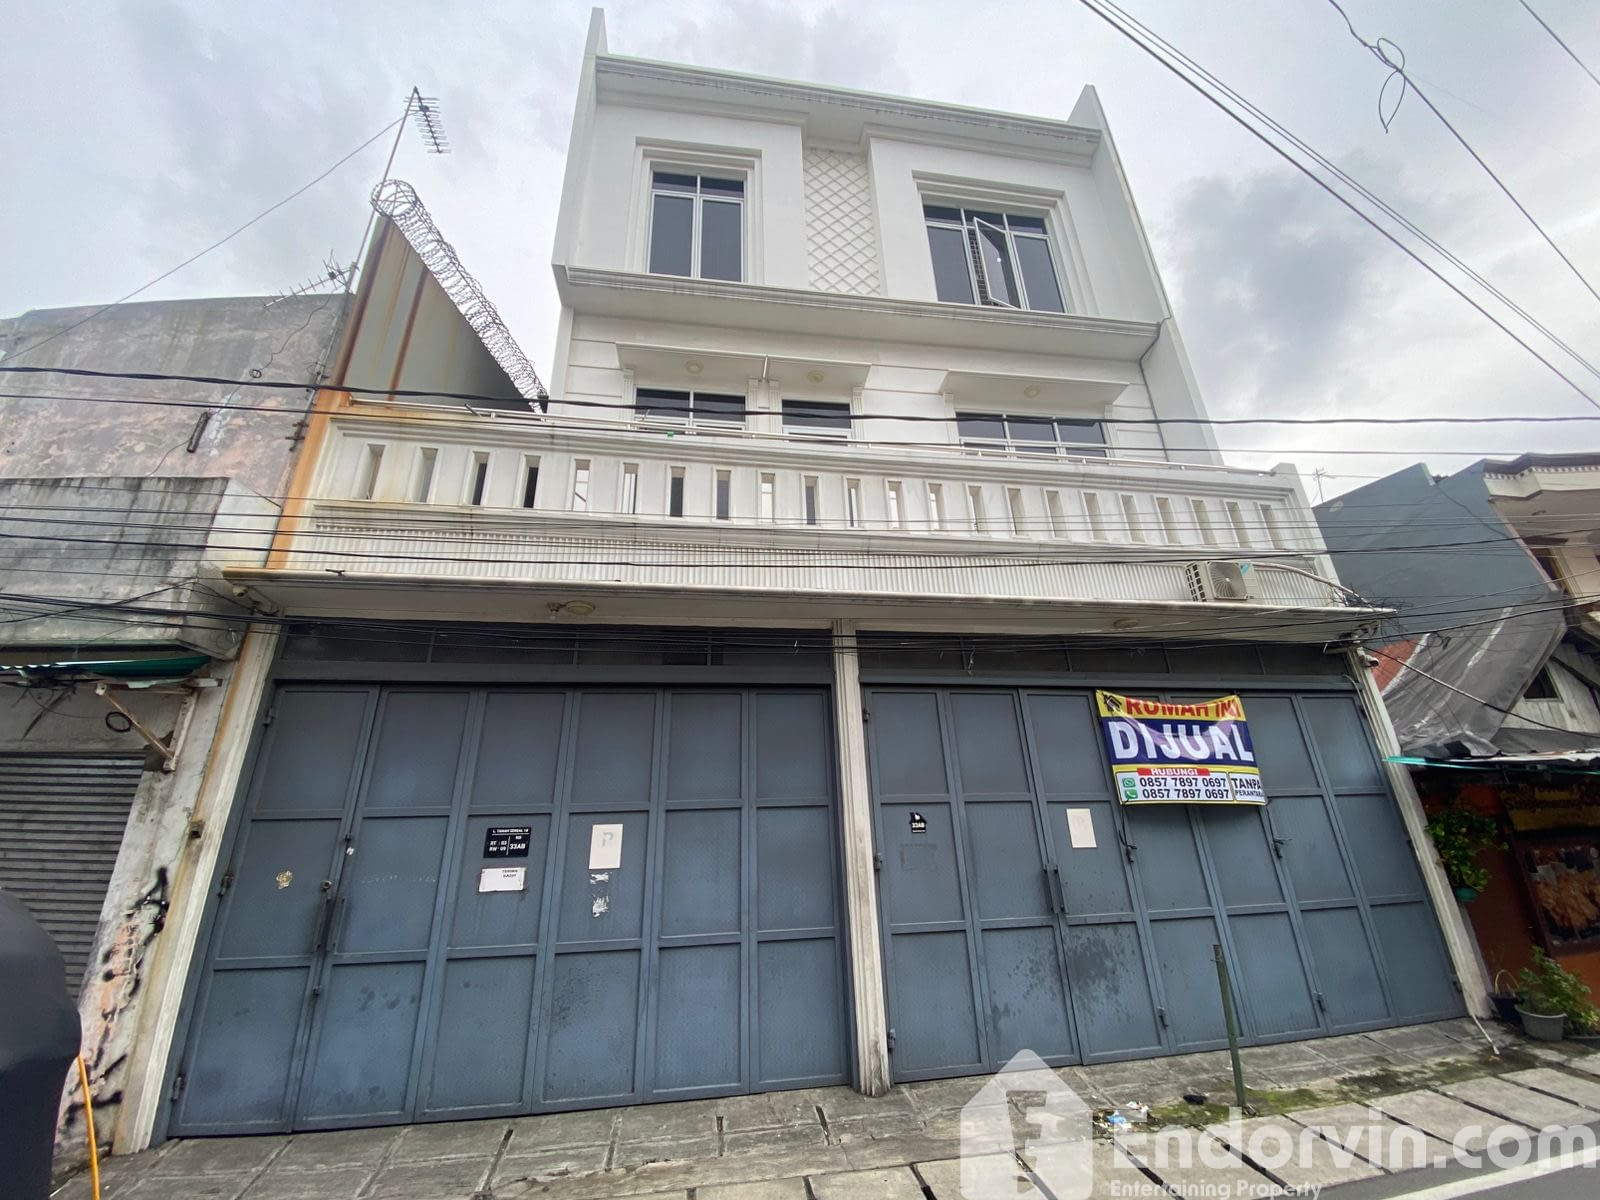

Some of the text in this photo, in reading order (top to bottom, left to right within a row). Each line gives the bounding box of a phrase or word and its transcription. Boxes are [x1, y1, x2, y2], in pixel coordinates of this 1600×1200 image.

[1215, 699, 1241, 718] INI
[1108, 721, 1254, 761] DIJUAL
[1151, 768, 1199, 776] HUBUNGI
[1140, 777, 1226, 788] 0857 7897 0697
[1142, 788, 1230, 799] 0857 7897 0697
